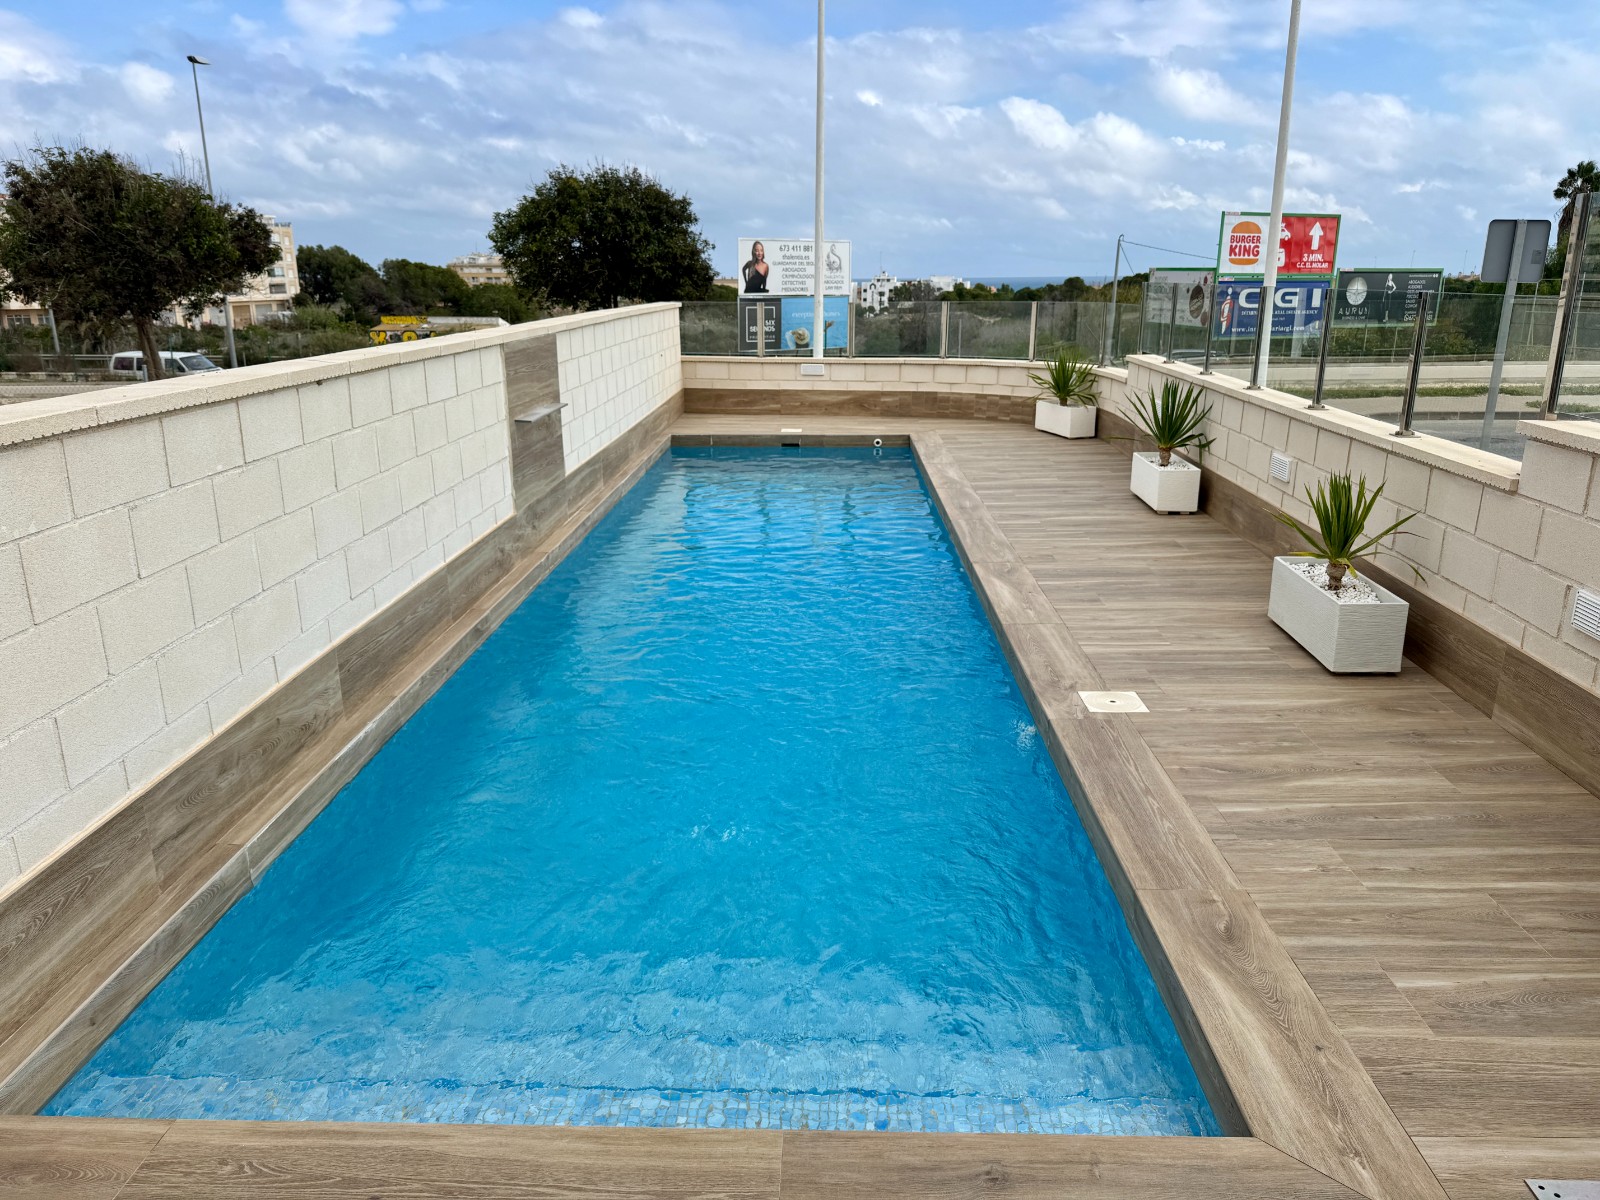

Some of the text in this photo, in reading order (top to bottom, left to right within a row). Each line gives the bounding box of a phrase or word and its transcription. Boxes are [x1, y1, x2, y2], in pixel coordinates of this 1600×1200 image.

[1230, 235, 1261, 244] BURGER
[1229, 245, 1260, 257] KING
[1309, 254, 1324, 262] MIN.
